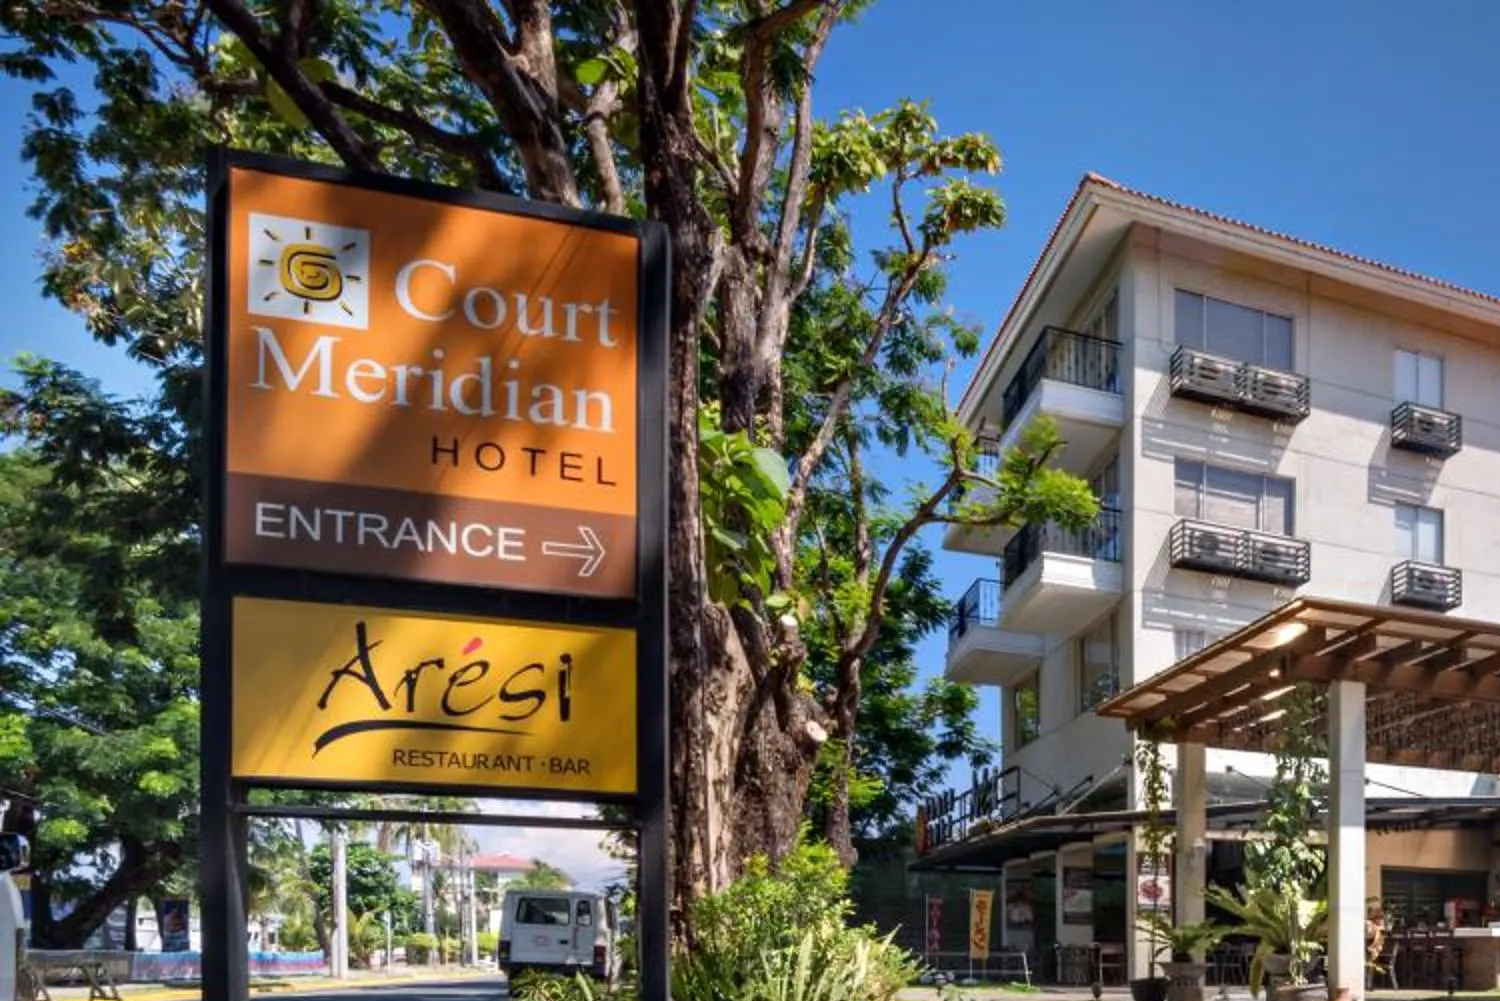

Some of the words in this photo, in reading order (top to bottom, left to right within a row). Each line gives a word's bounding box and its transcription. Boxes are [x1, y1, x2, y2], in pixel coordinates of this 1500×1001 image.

[395, 259, 619, 348] Court
[251, 325, 615, 433] Meridian
[431, 435, 618, 487] HOTEL
[254, 502, 528, 561] ENTRANCE
[315, 620, 575, 722] Arési
[392, 748, 534, 773] RESTAURANT
[548, 756, 592, 776] BAR
